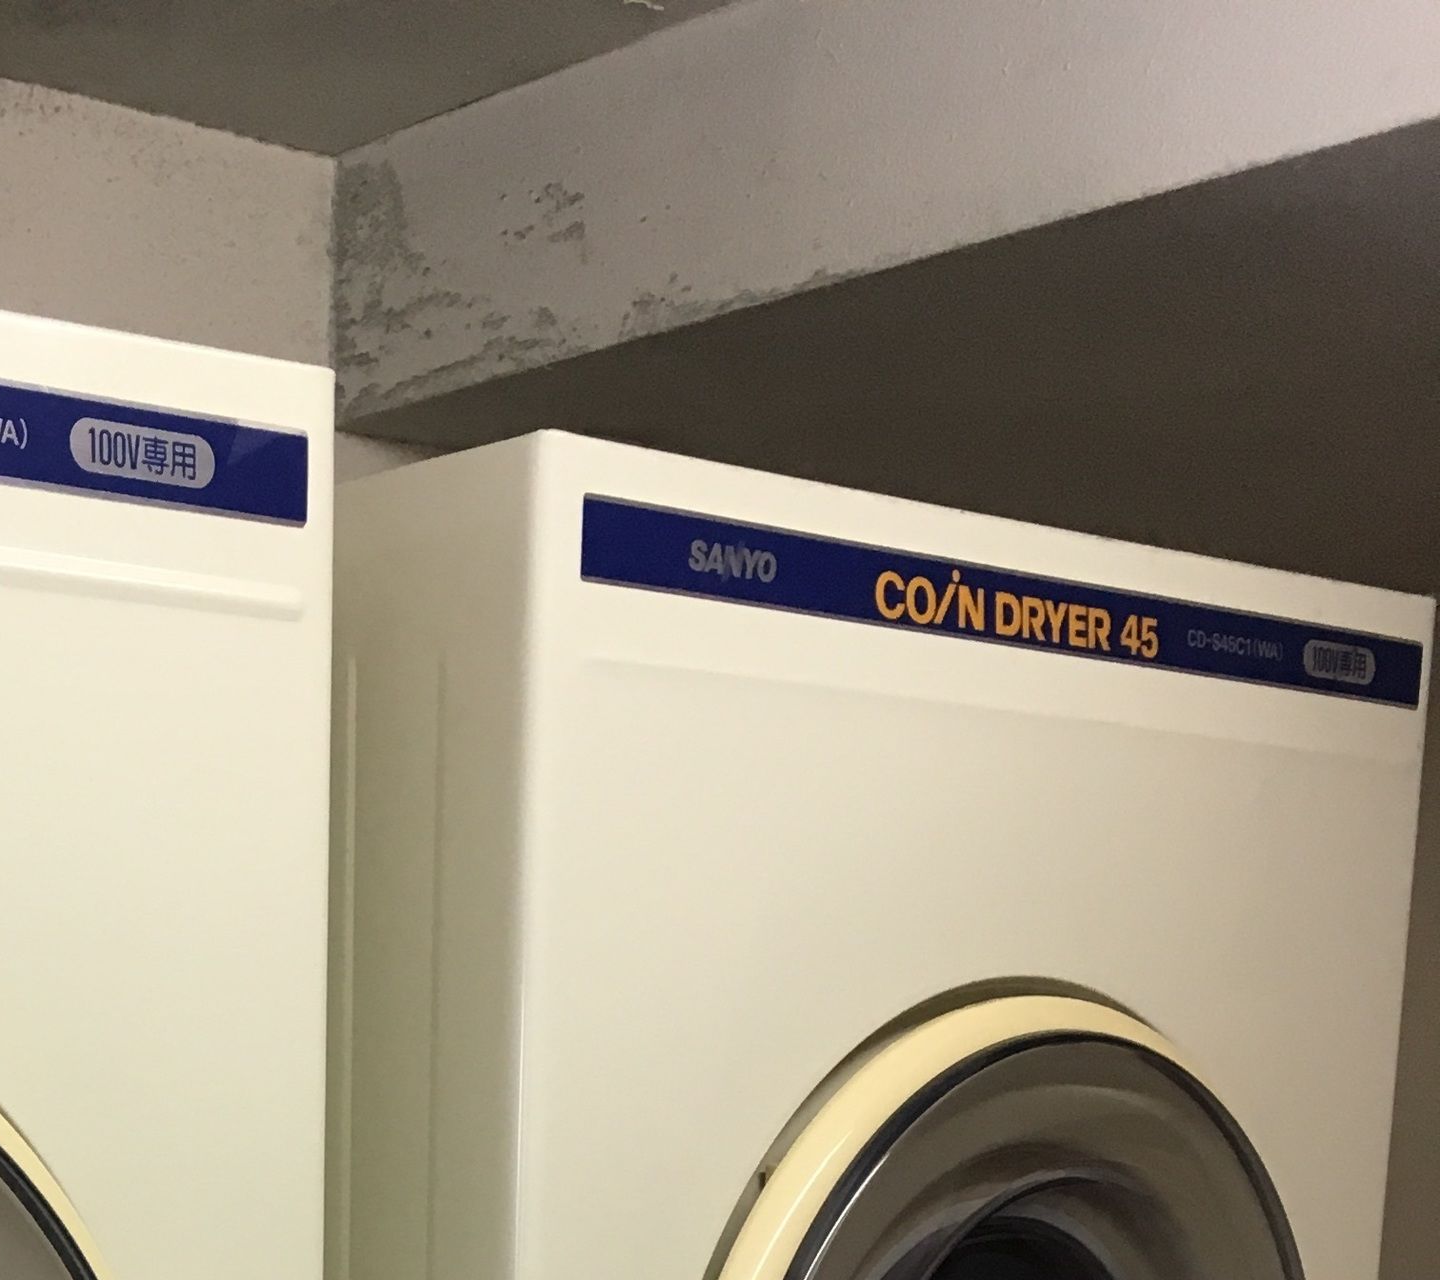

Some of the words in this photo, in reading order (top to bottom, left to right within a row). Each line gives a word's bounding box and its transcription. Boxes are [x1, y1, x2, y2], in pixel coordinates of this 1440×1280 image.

[84, 425, 198, 483] 100V専用
[688, 539, 778, 584] SANYO
[994, 593, 1111, 652] DRYER
[1119, 616, 1159, 659] 45
